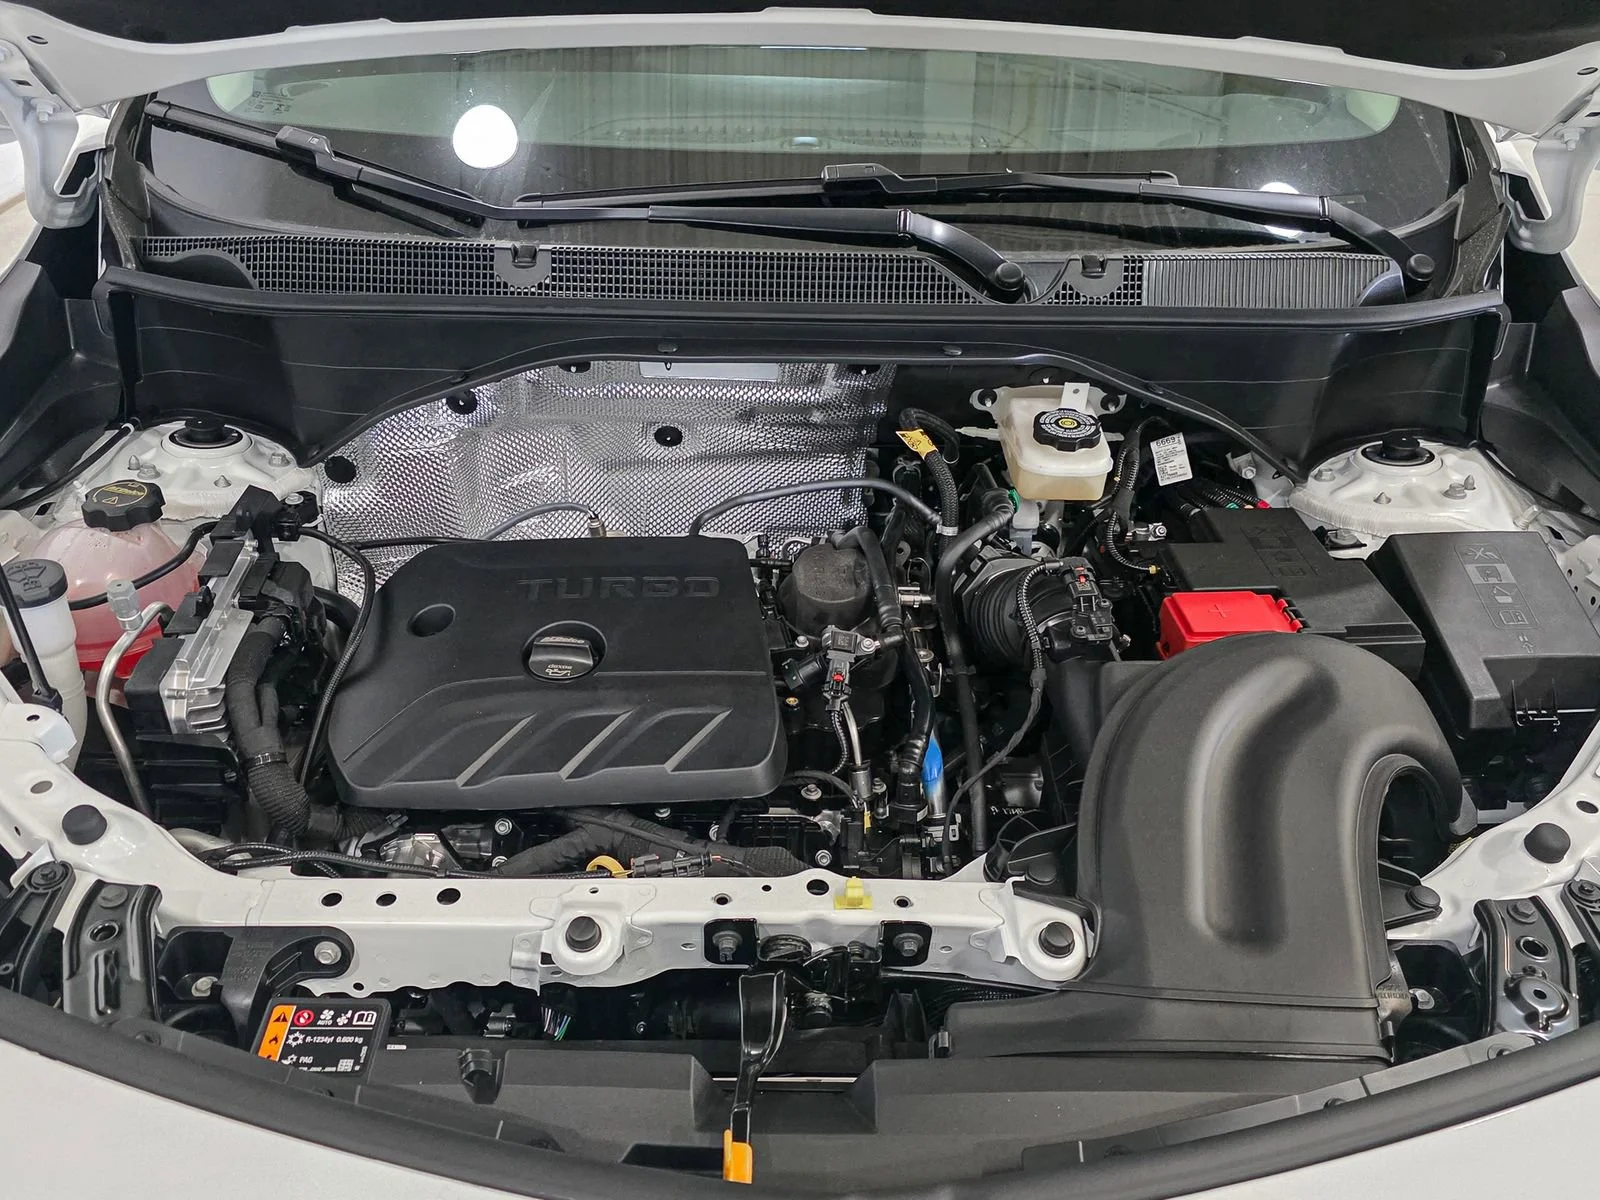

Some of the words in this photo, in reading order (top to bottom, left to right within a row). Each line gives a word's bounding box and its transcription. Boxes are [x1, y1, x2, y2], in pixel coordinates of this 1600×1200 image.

[1155, 436, 1176, 447] 6669
[517, 576, 720, 600] TURBO
[305, 1036, 334, 1044] R-1234yf
[354, 1036, 364, 1044] kg
